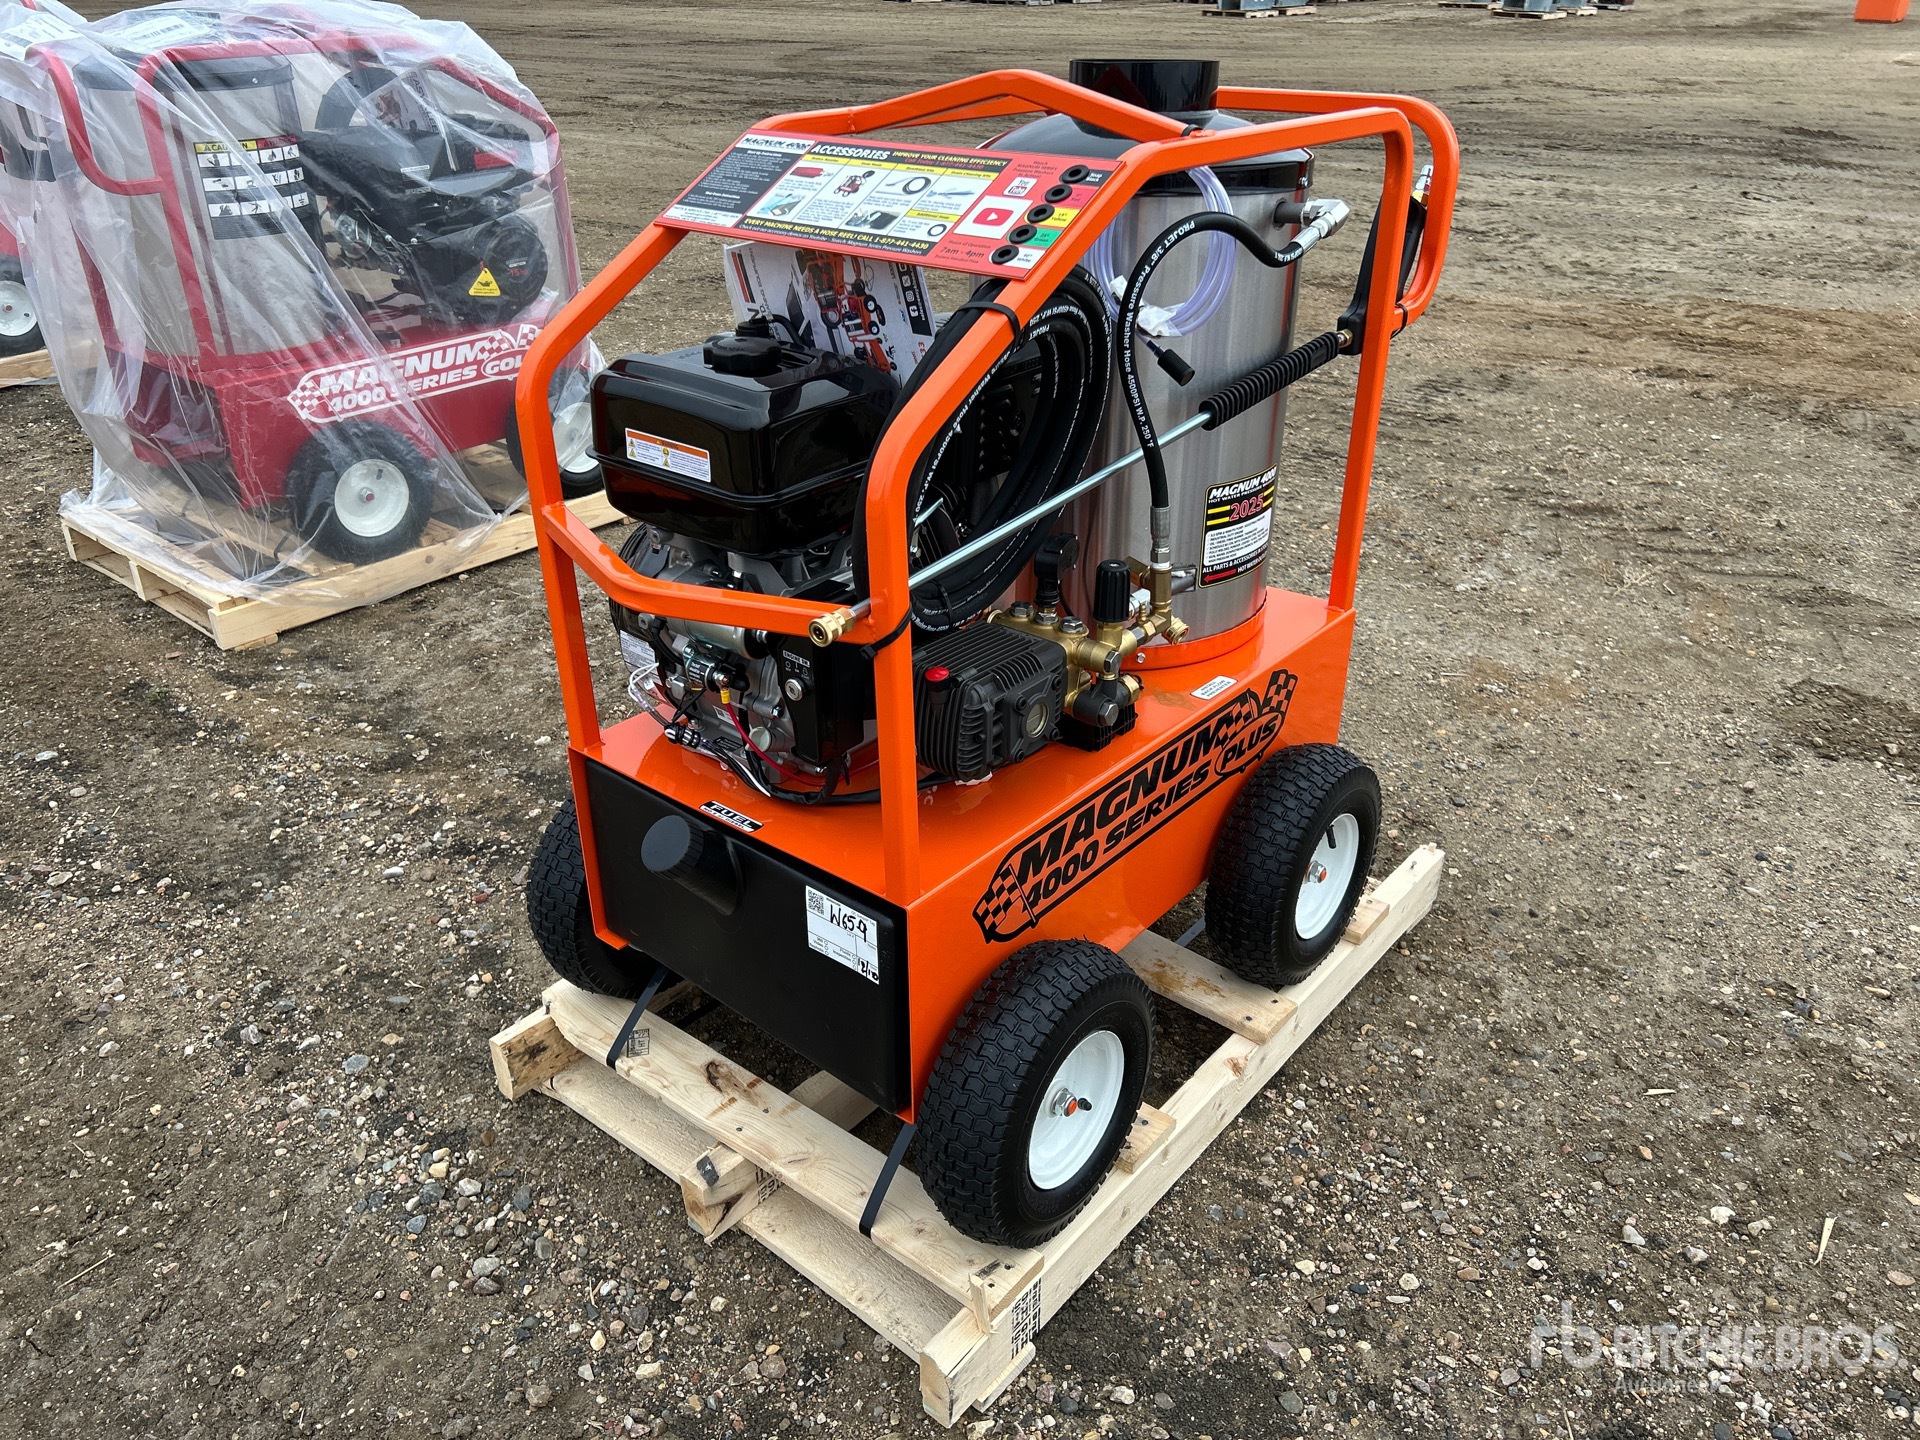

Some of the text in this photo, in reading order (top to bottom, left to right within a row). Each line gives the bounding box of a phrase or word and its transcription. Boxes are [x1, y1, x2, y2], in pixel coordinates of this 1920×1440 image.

[811, 144, 891, 160] ACCESSORIES
[892, 151, 920, 159] IMPROVE
[937, 155, 969, 163] CLEANING
[969, 158, 1007, 167] EFFICIENCY
[744, 218, 764, 226] EVERY
[763, 221, 793, 231] MACHINE
[792, 225, 814, 234] NEEDS
[819, 229, 839, 237] HOSE
[838, 231, 857, 240] REEL!
[857, 233, 874, 242] CALL
[874, 236, 929, 250] 1-877-441-4430
[1164, 219, 1195, 248] PROJET
[940, 246, 958, 255] 7am
[965, 249, 984, 259] 4pm
[1128, 265, 1151, 313] Pressure
[1123, 312, 1135, 349] Washer
[484, 354, 523, 375] GOL
[1123, 350, 1132, 373] Hose
[328, 386, 389, 413] 4000
[968, 373, 991, 406] Washer
[1126, 373, 1141, 407] 4500PSI
[952, 404, 969, 429] Hose
[1135, 406, 1147, 425] W.P.
[1141, 424, 1152, 440] 250
[931, 429, 953, 470] 4500PSI
[1209, 476, 1261, 500] MAGNUM
[1221, 493, 1241, 501] WATER
[1229, 492, 1265, 522] 2025
[1213, 562, 1229, 571] PARTS
[1233, 551, 1258, 565] ACCESSORIES
[1237, 564, 1247, 573] HOT
[1220, 714, 1279, 769] PLUS
[710, 804, 752, 828] FUEL
[1016, 722, 1226, 886] MAGNUM
[1021, 761, 1212, 910] 4000 SERIES
[830, 904, 868, 943] W659
